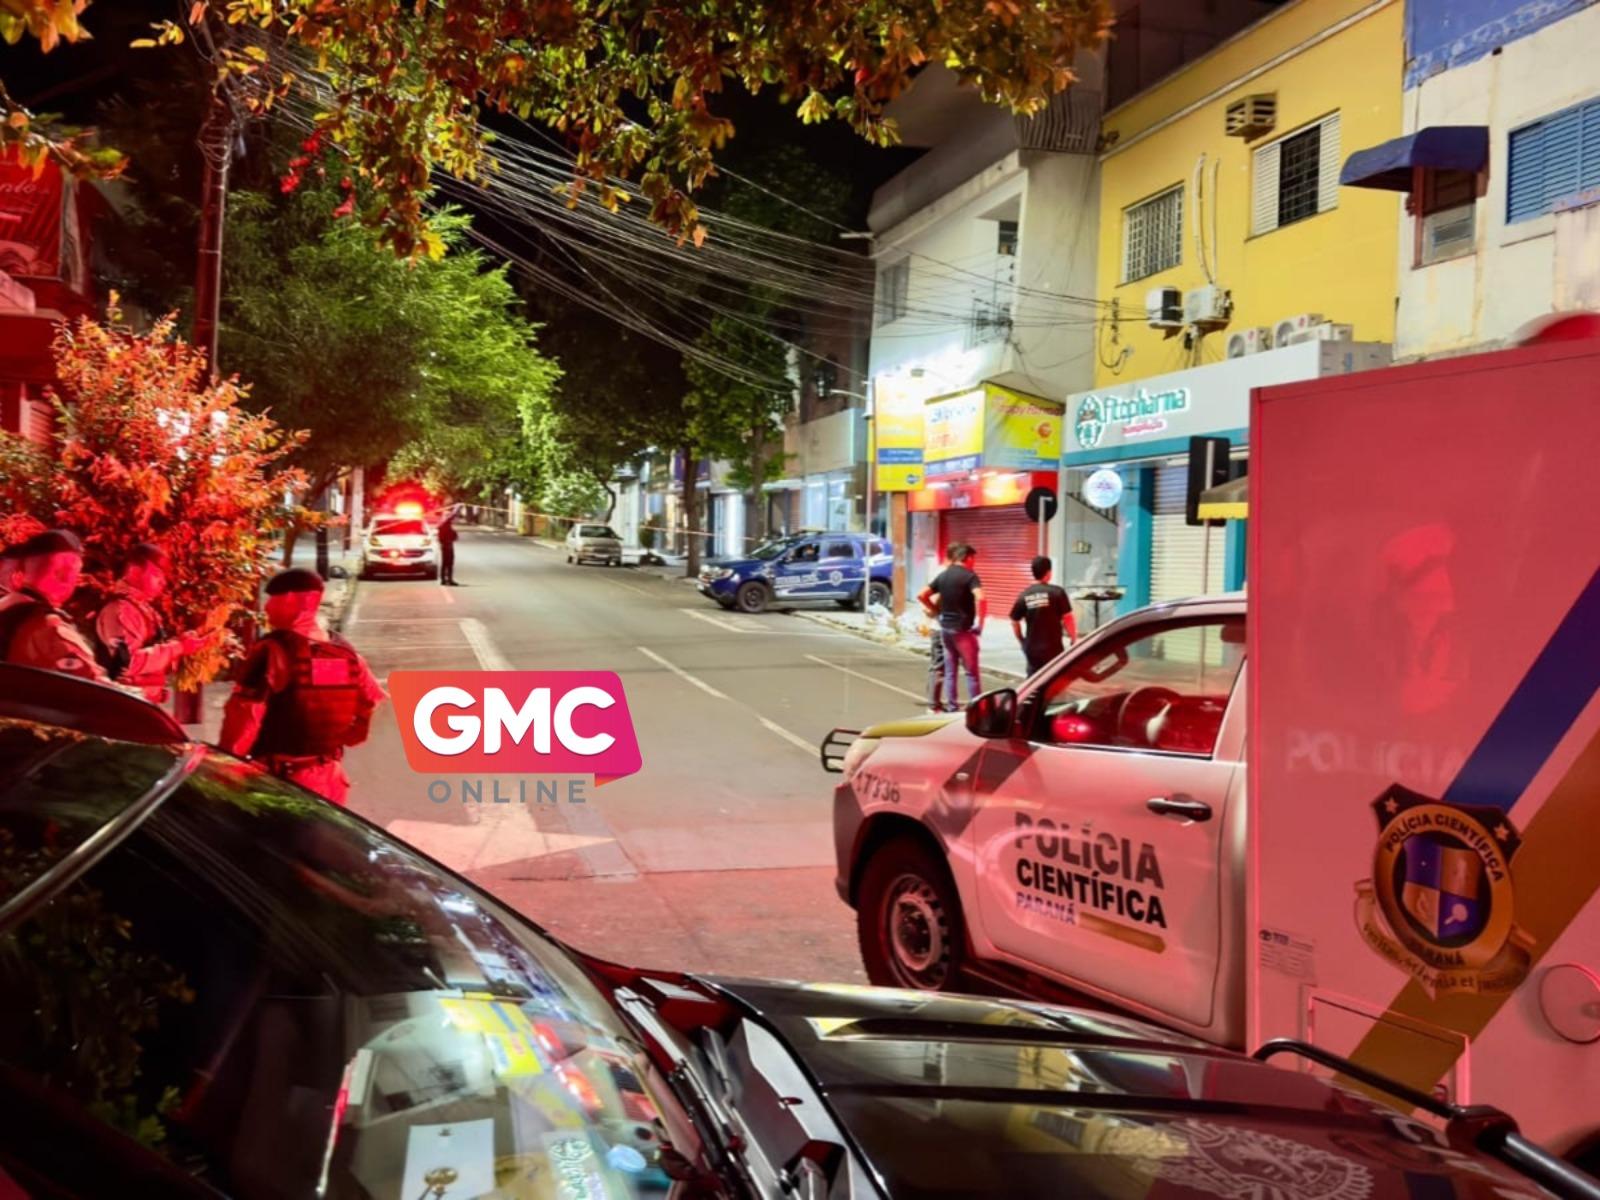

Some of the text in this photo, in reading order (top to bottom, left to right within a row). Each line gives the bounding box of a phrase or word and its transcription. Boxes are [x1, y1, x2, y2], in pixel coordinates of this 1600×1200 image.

[1015, 811, 1165, 890] POLÍCIA
[1434, 813, 1505, 882] CIENTÍFICA
[1016, 858, 1167, 929] CIENTÍFICA
